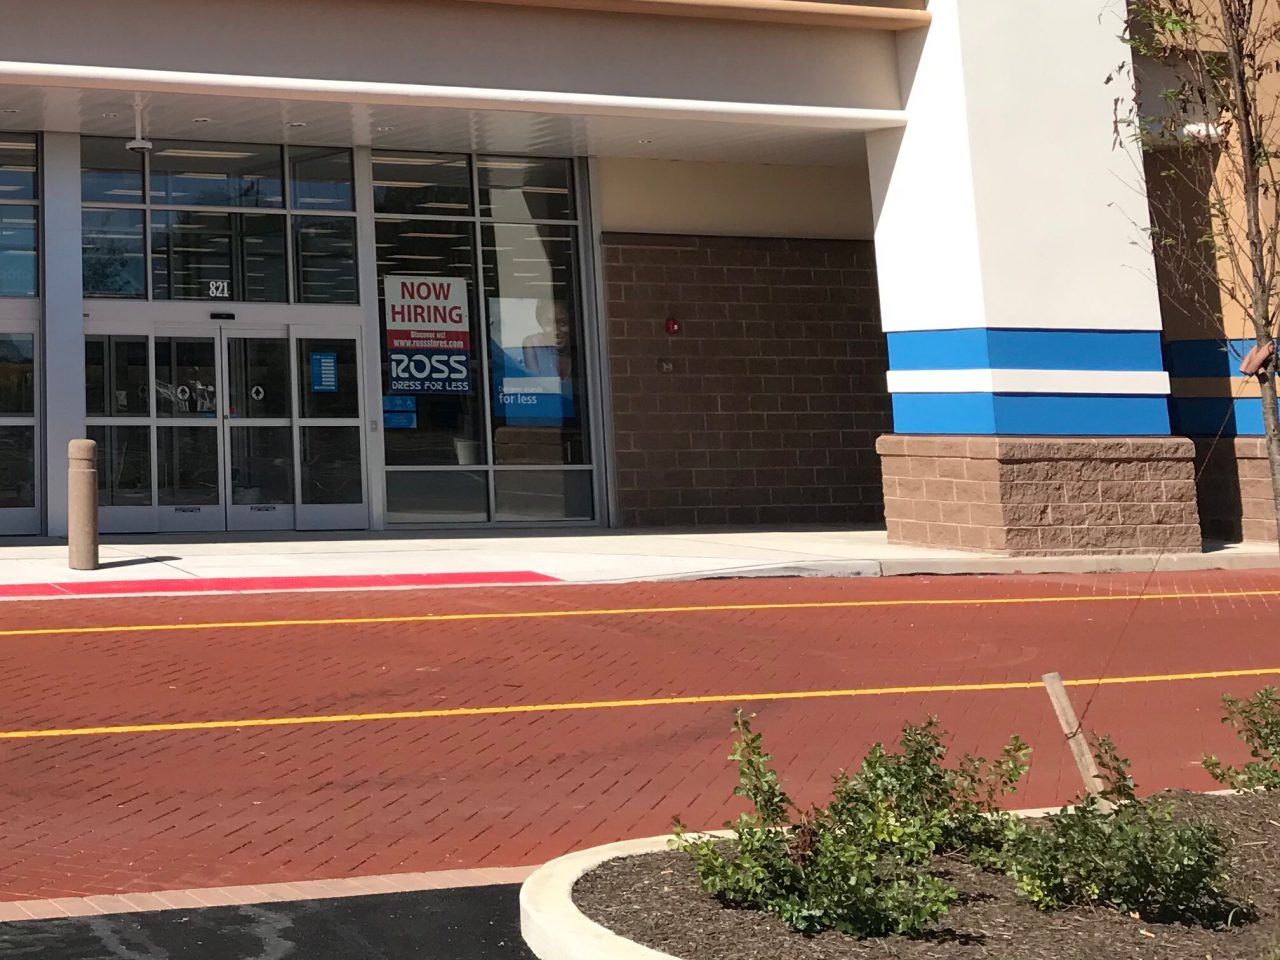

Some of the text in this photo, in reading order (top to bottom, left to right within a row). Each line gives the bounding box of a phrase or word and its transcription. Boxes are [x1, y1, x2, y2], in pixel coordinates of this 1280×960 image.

[209, 281, 229, 297] 821
[400, 281, 451, 301] NOW
[391, 304, 463, 324] HIRING
[393, 339, 464, 348] www.rossstores.com
[391, 354, 467, 378] ROSS
[392, 381, 469, 391] DRESS FOR LESS
[499, 392, 537, 404] for less
